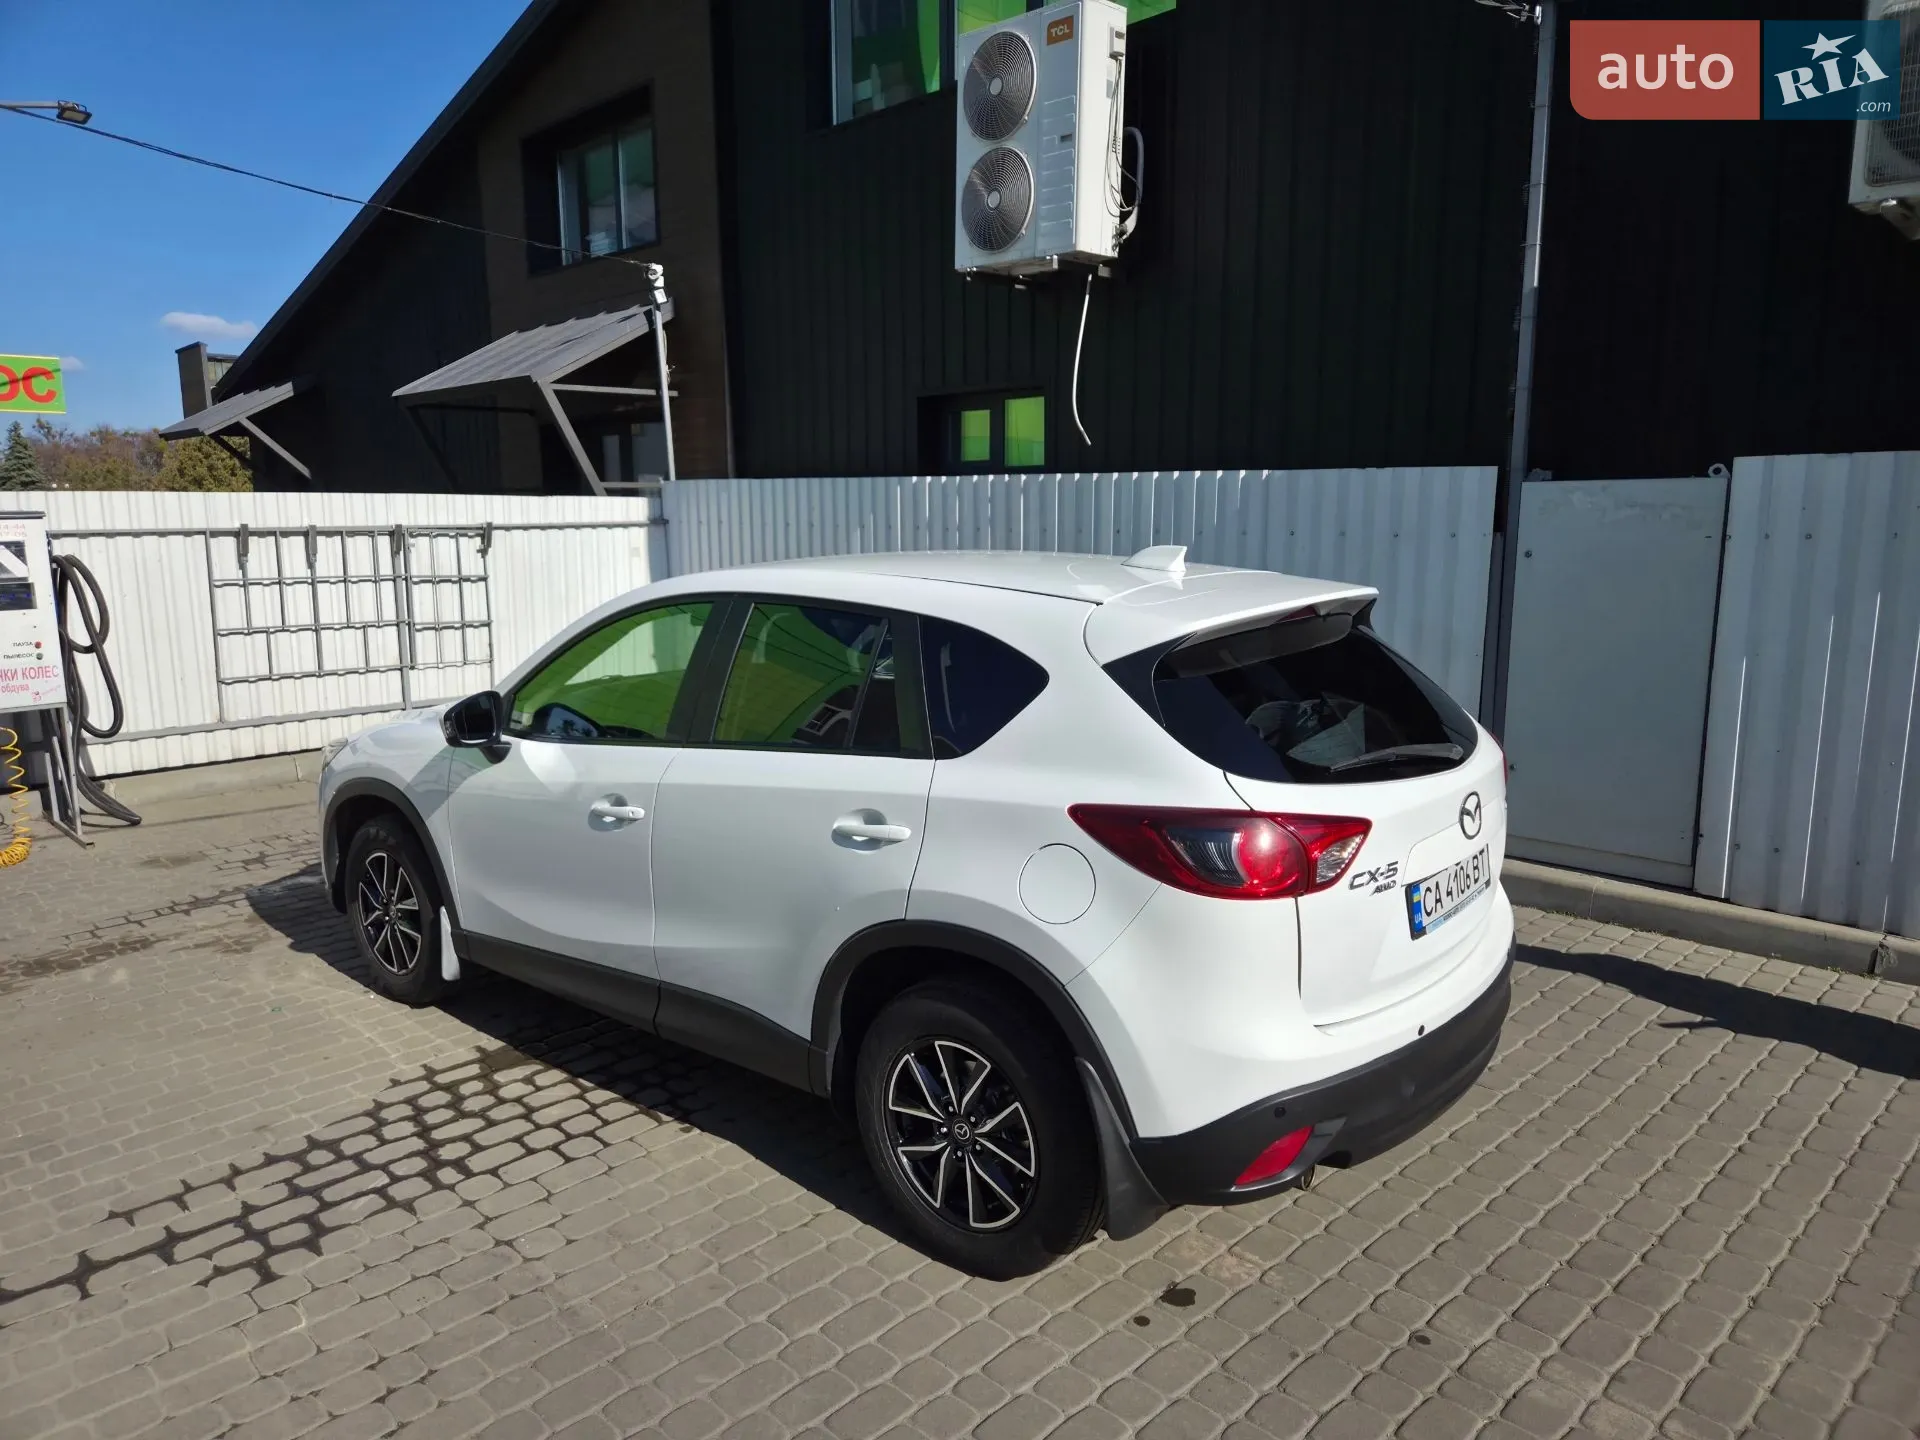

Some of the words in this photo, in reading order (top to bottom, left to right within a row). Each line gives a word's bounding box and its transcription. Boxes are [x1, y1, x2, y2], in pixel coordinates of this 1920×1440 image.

[1050, 24, 1070, 37] TCL
[3, 652, 35, 660] ПЫЛЕСОС
[22, 664, 60, 680] КОЛЕС
[1349, 861, 1399, 890] CX-5
[1446, 859, 1471, 902] 4106
[1369, 880, 1397, 897] AWD
[1414, 912, 1423, 924] UA
